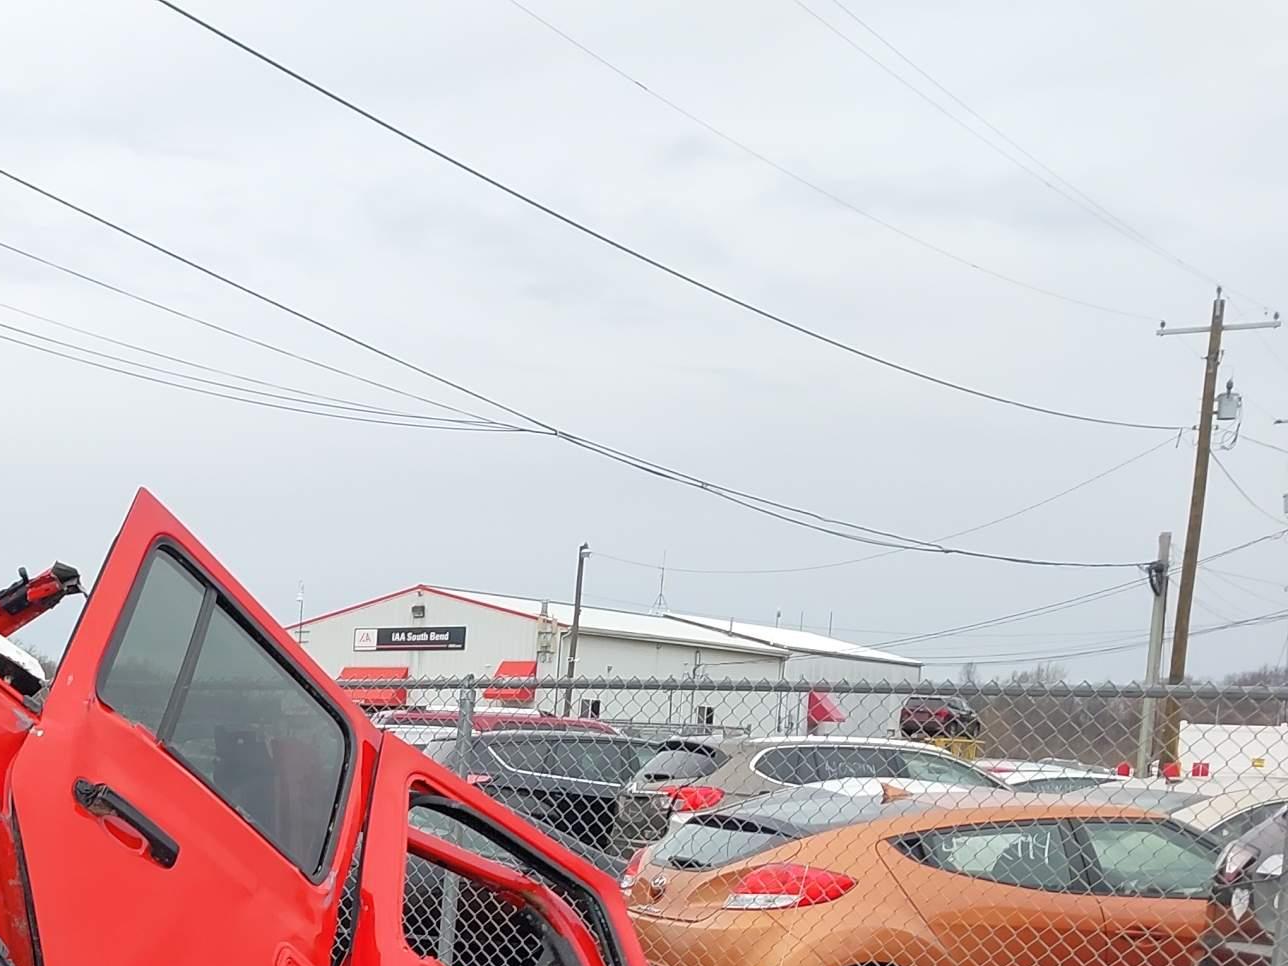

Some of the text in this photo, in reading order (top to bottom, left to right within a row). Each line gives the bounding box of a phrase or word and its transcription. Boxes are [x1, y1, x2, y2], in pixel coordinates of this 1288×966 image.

[391, 631, 450, 642] IAA South Bend
